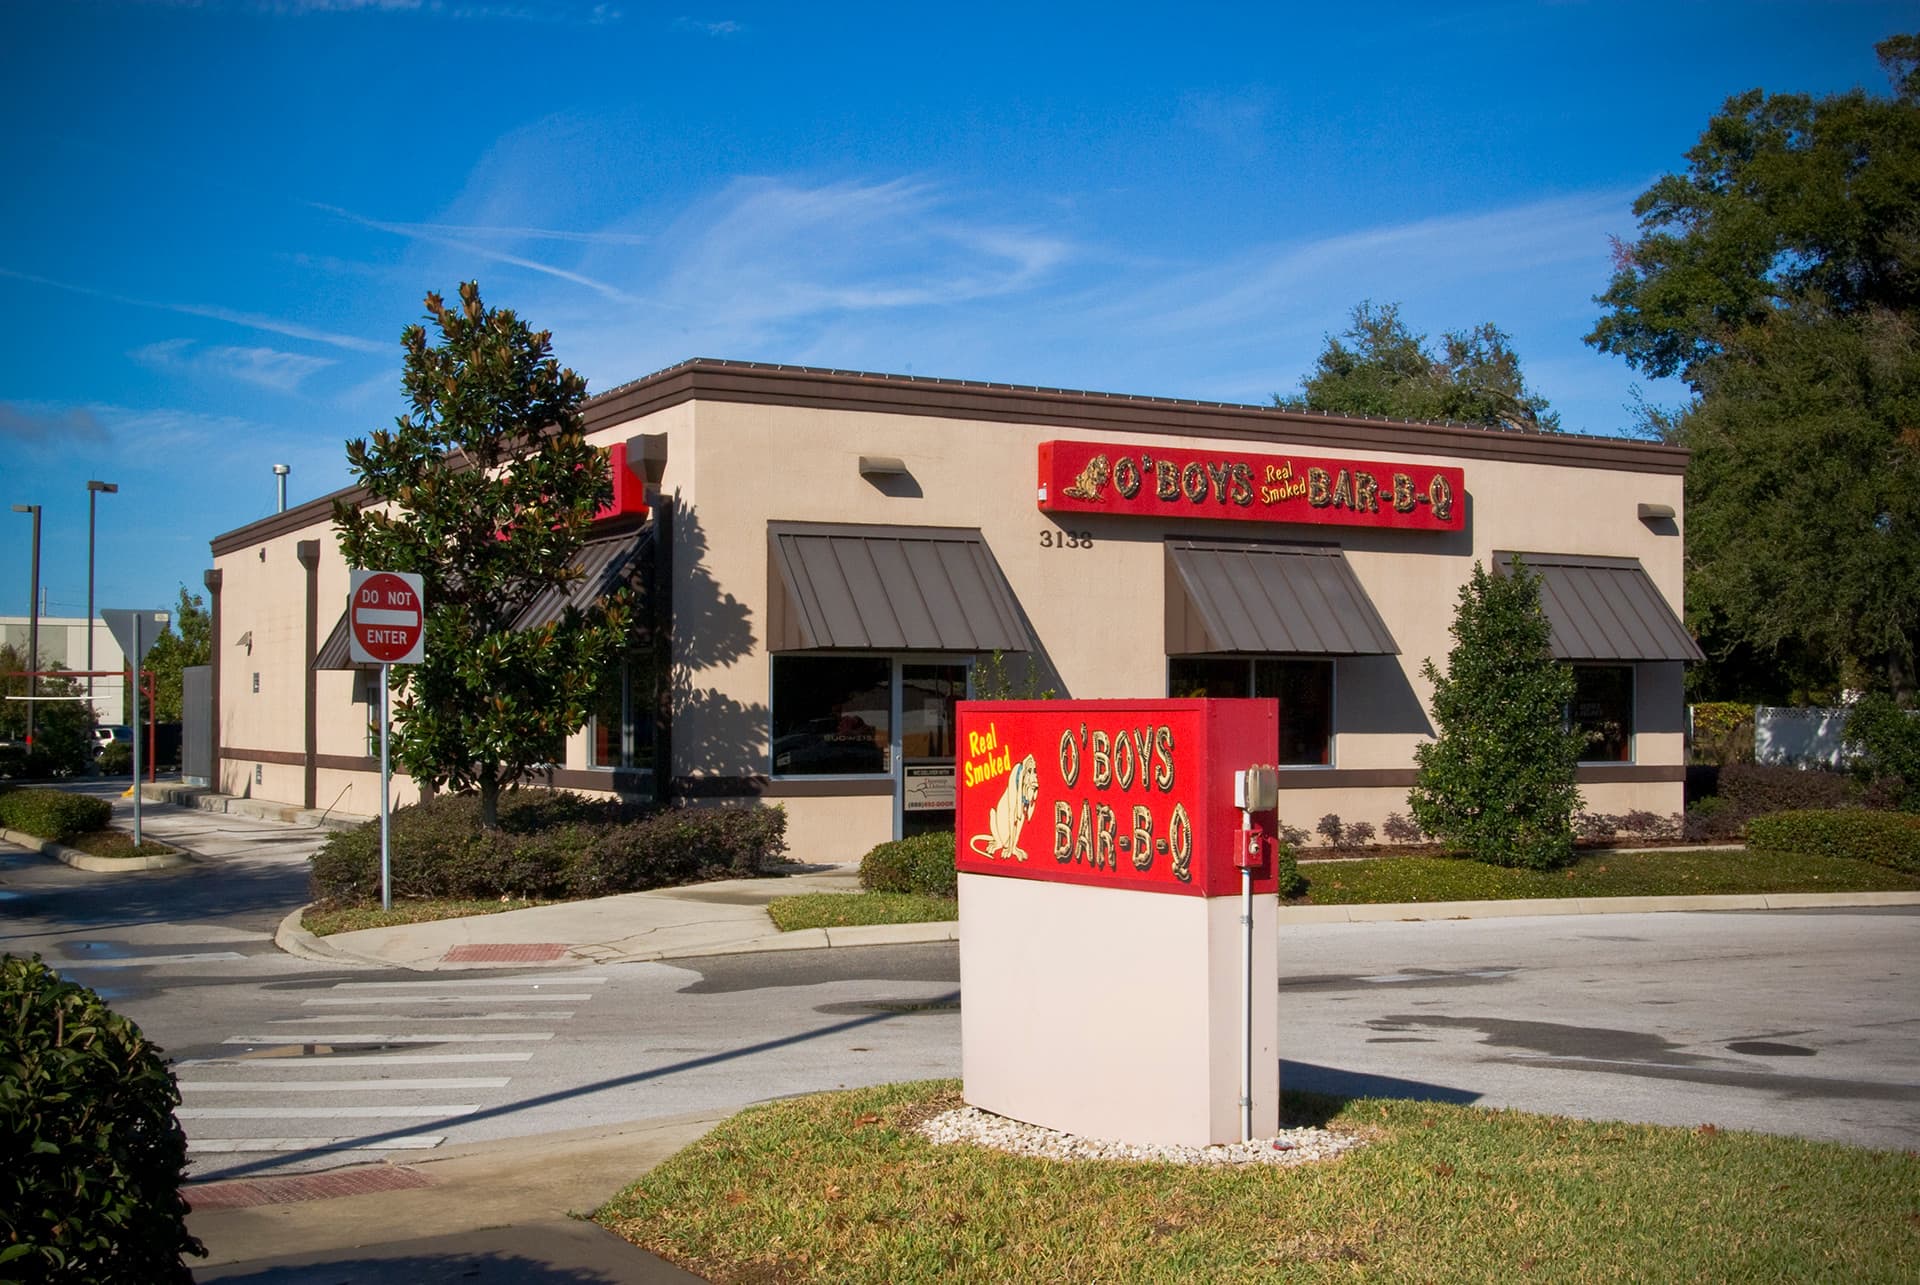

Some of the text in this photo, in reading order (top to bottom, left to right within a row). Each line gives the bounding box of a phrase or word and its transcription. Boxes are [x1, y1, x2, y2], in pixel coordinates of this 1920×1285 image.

[1113, 453, 1255, 507] O'BOYS
[1266, 460, 1293, 481] Real
[1261, 478, 1307, 505] Smoked
[1307, 466, 1453, 522] BAR-B-Q
[1039, 530, 1094, 550] 3138
[362, 589, 412, 606] DO NOT
[367, 629, 407, 645] ENTER
[969, 722, 997, 759] Real
[1059, 722, 1175, 792] O'BOYS
[964, 747, 1011, 788] Smoked
[1054, 799, 1193, 884] BAR-B-Q
